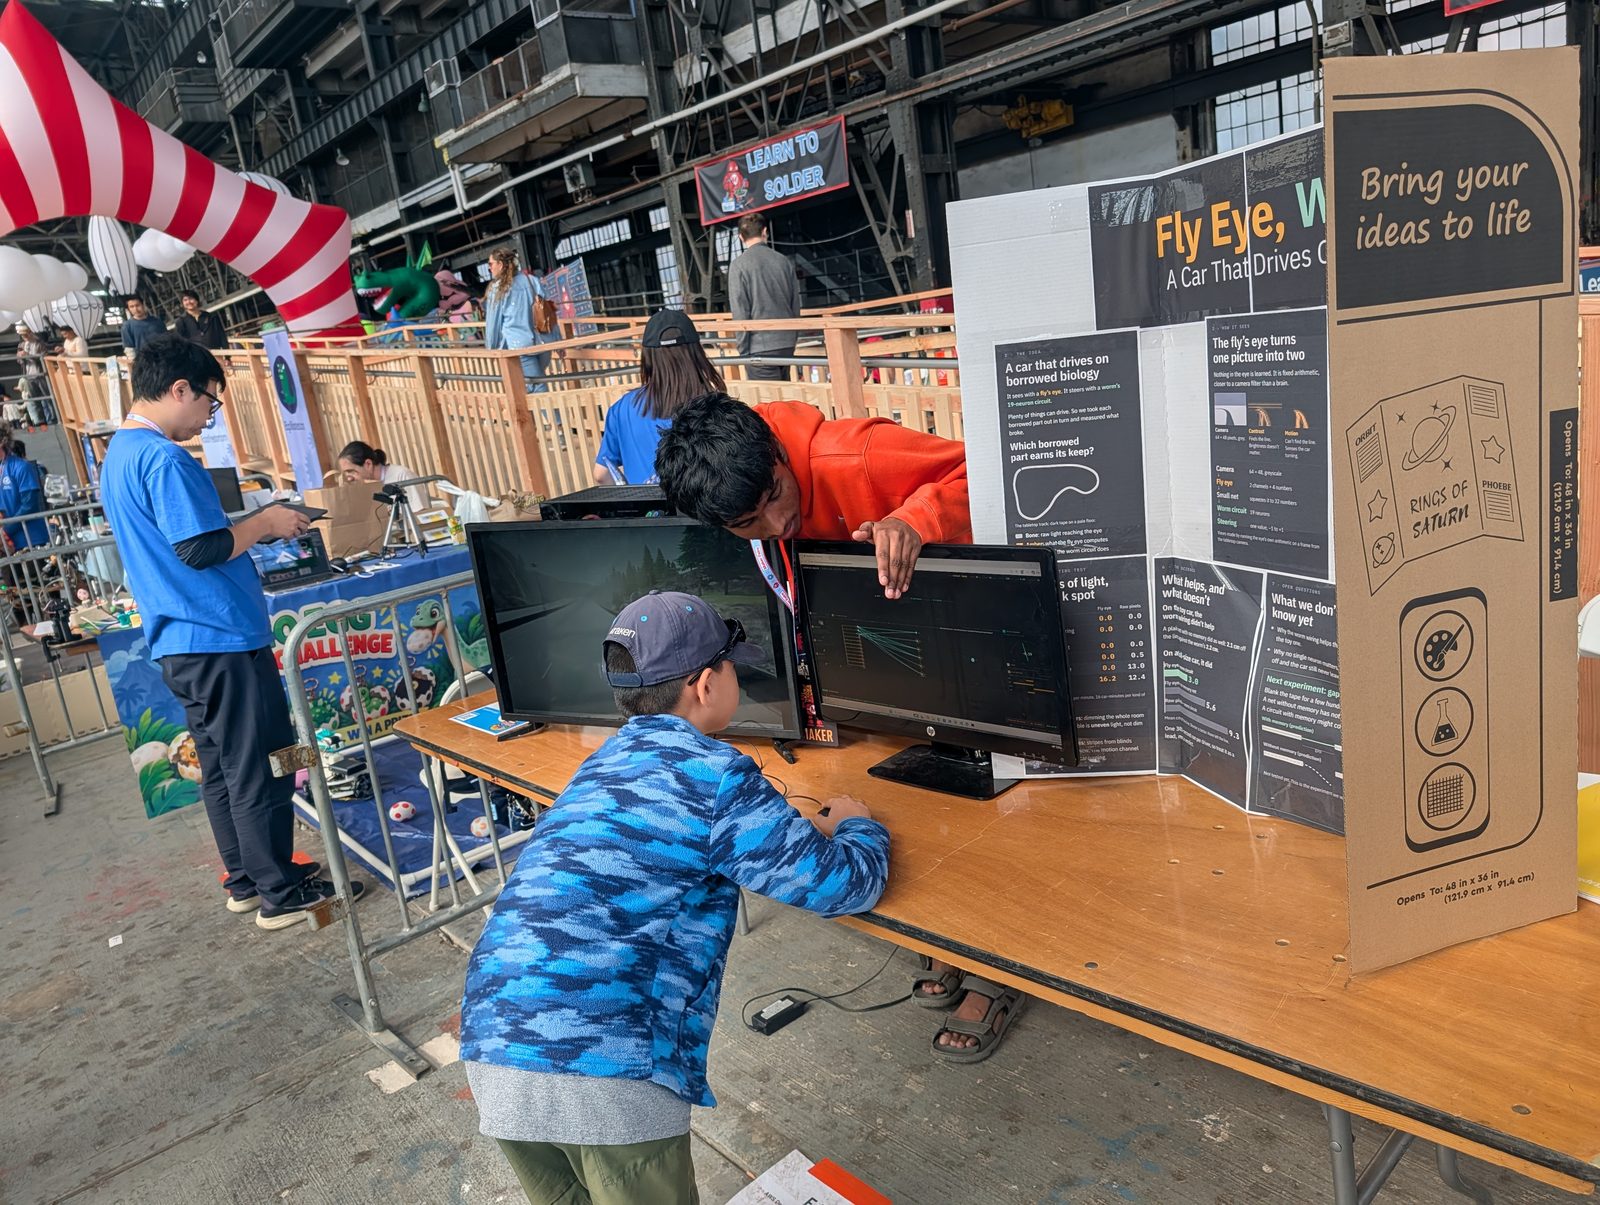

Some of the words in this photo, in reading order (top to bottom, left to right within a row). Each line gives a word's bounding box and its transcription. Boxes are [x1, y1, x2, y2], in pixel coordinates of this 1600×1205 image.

[746, 138, 795, 174] LEARN
[796, 131, 819, 156] TO
[764, 165, 825, 201] SOLDER
[1361, 162, 1444, 205] Bring
[1456, 161, 1529, 201] your
[1156, 211, 1202, 264] Fly
[1211, 200, 1286, 257] Eye,
[1356, 212, 1430, 250] ideas
[1442, 211, 1473, 241] to
[1488, 199, 1531, 237] life
[1166, 270, 1177, 291] A
[1181, 265, 1207, 289] Car
[1211, 257, 1251, 282] That
[1254, 249, 1311, 277] Drives
[1213, 337, 1229, 349] The
[1231, 336, 1250, 350] fly's
[1252, 338, 1268, 349] eye
[1270, 335, 1296, 346] turns
[1005, 364, 1013, 373] A
[1016, 363, 1032, 372] car
[1035, 359, 1057, 370] that
[1060, 356, 1093, 368] drives
[1096, 355, 1109, 364] on
[1213, 354, 1229, 364] one
[1231, 351, 1263, 365] picture
[1265, 350, 1284, 362] into
[1286, 350, 1305, 361] two
[1007, 372, 1057, 386] borrowed
[1060, 369, 1100, 381] biology
[1355, 423, 1377, 446] ORBIT
[1564, 421, 1572, 457] Opens
[1010, 441, 1036, 451] Which
[1039, 437, 1079, 448] borrowed
[1011, 452, 1028, 463] part
[1030, 452, 1054, 460] earns
[1056, 450, 1066, 458] its
[1069, 447, 1094, 458] keep?
[1216, 465, 1235, 473] Camera
[1565, 462, 1573, 479] To:
[1482, 480, 1512, 491] PHOEBE
[1565, 483, 1573, 496] 48
[1411, 487, 1447, 514] RINGS
[1453, 480, 1468, 498] OF
[1553, 482, 1563, 514] (121.9
[1565, 499, 1573, 509] in
[1218, 518, 1237, 528] Steering
[1554, 519, 1560, 533] cm
[1565, 522, 1573, 537] 36
[1565, 540, 1571, 549] in
[1554, 549, 1562, 571] 91.4
[1068, 578, 1078, 588] of
[1081, 576, 1109, 589] light,
[1162, 574, 1183, 586] What
[1185, 577, 1207, 593] helps,
[1209, 584, 1225, 595] and
[1553, 575, 1562, 594] cm)
[1072, 590, 1095, 602] spot
[1163, 587, 1182, 599] what
[1183, 591, 1210, 606] doesn't
[1272, 593, 1296, 608] What
[1298, 601, 1313, 611] we
[1205, 621, 1215, 631] help
[1272, 607, 1296, 622] know
[1298, 615, 1313, 627] yet
[1277, 627, 1286, 635] Why
[1306, 635, 1319, 645] wiring
[1320, 638, 1332, 647] helps
[273, 634, 394, 670] CALLNGE
[1274, 648, 1285, 657] Why
[1293, 653, 1307, 661] single
[1189, 676, 1199, 685] 3.0
[1266, 675, 1283, 685] Next
[1284, 679, 1326, 694] experiment:
[1328, 689, 1340, 699] gap
[1265, 687, 1279, 696] Blank
[1280, 690, 1288, 698] the
[1289, 693, 1301, 702] tape
[1302, 695, 1310, 703] for
[1315, 698, 1325, 706] few
[1206, 702, 1216, 712] 5.6
[1277, 699, 1296, 709] without
[1297, 705, 1319, 716] memory
[1320, 708, 1330, 716] has
[1266, 707, 1282, 715] circuit
[1283, 710, 1294, 718] with
[1295, 714, 1316, 724] memory
[1317, 719, 1333, 728] might
[347, 725, 373, 740] WN
[375, 723, 383, 734] A
[1229, 729, 1240, 740] 9.3
[1397, 891, 1425, 906] Opens
[1430, 886, 1443, 896] To:
[1446, 881, 1457, 892] 48
[1459, 879, 1468, 888] in
[1478, 874, 1488, 884] 36
[1491, 870, 1499, 879] in
[1444, 890, 1469, 905] (121.9
[1471, 887, 1485, 897] cm
[1498, 878, 1516, 889] 91.4
[1517, 872, 1535, 885] cm)
